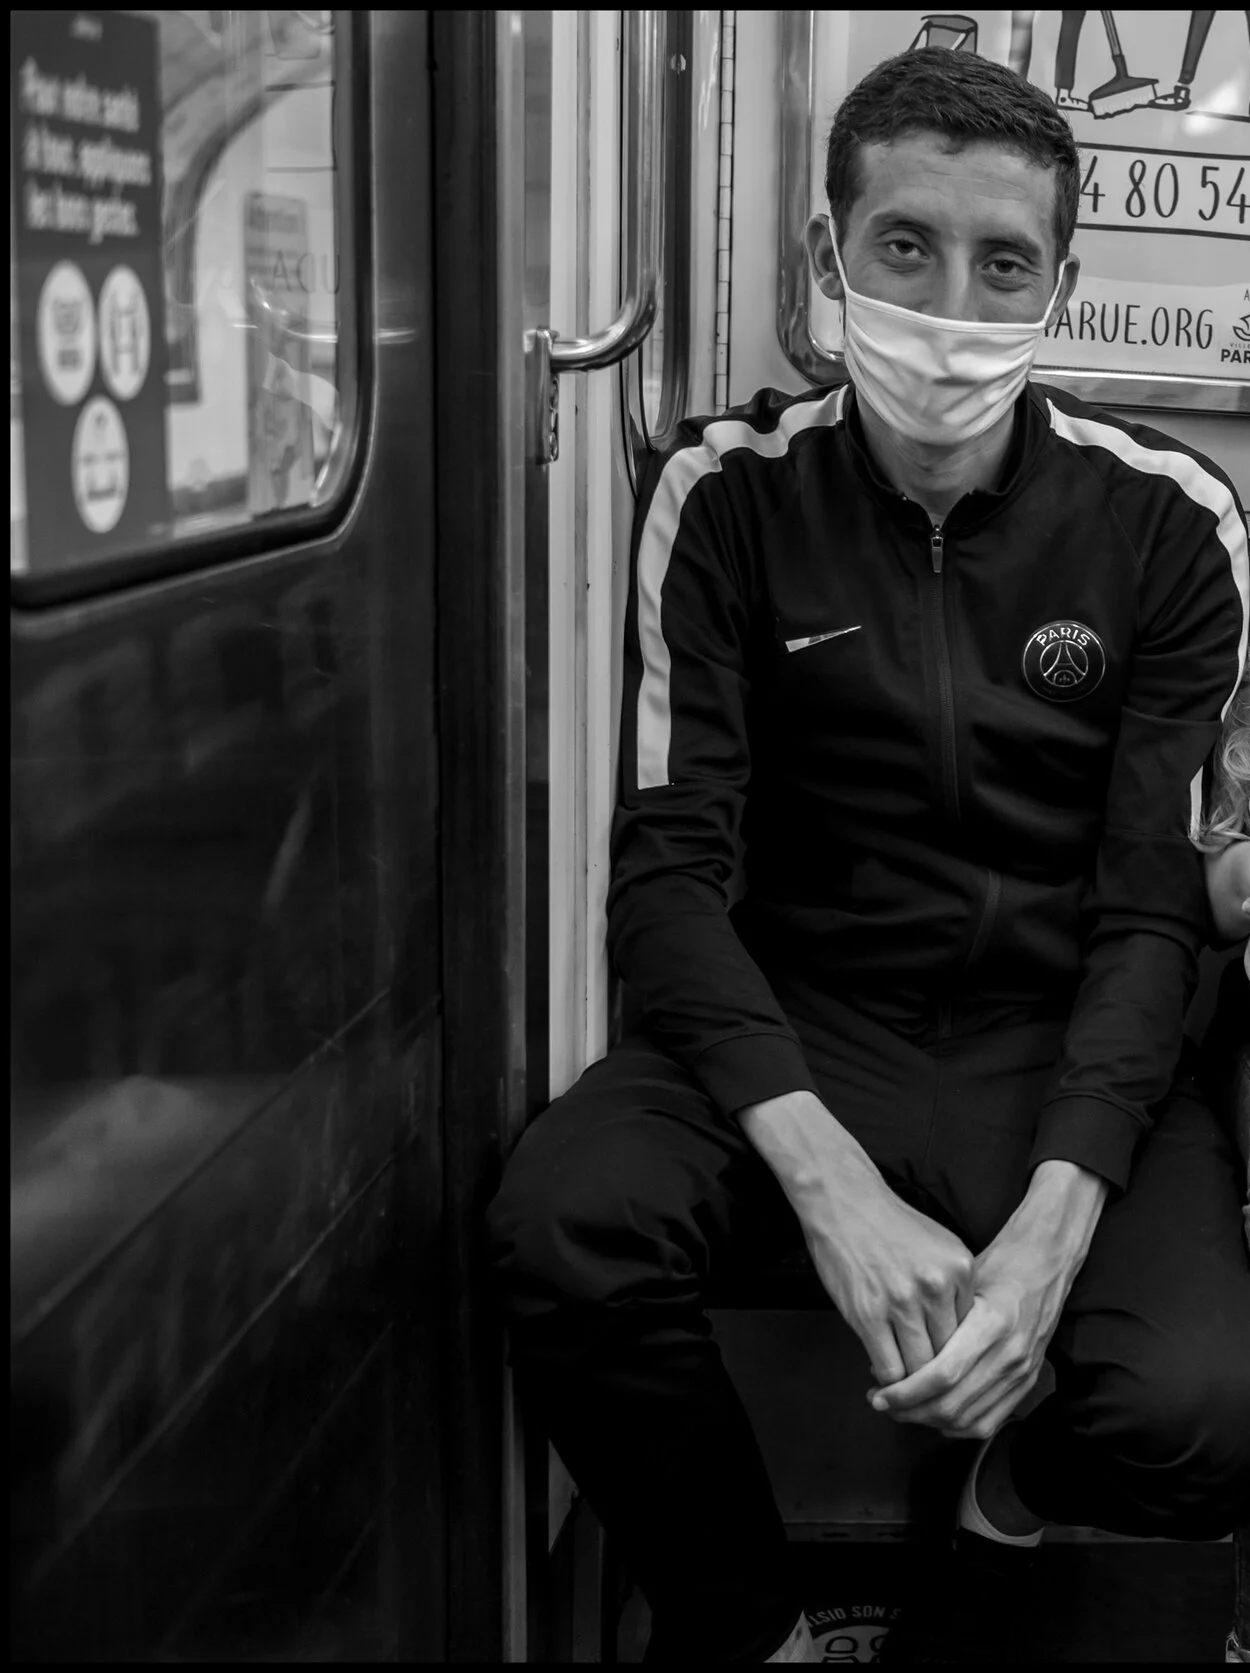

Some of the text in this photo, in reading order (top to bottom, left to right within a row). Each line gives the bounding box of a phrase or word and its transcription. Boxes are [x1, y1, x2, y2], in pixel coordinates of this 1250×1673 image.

[1125, 159, 1179, 218] 80
[1044, 300, 1214, 349] ARUE.ORG
[1036, 627, 1091, 647] PARIS
